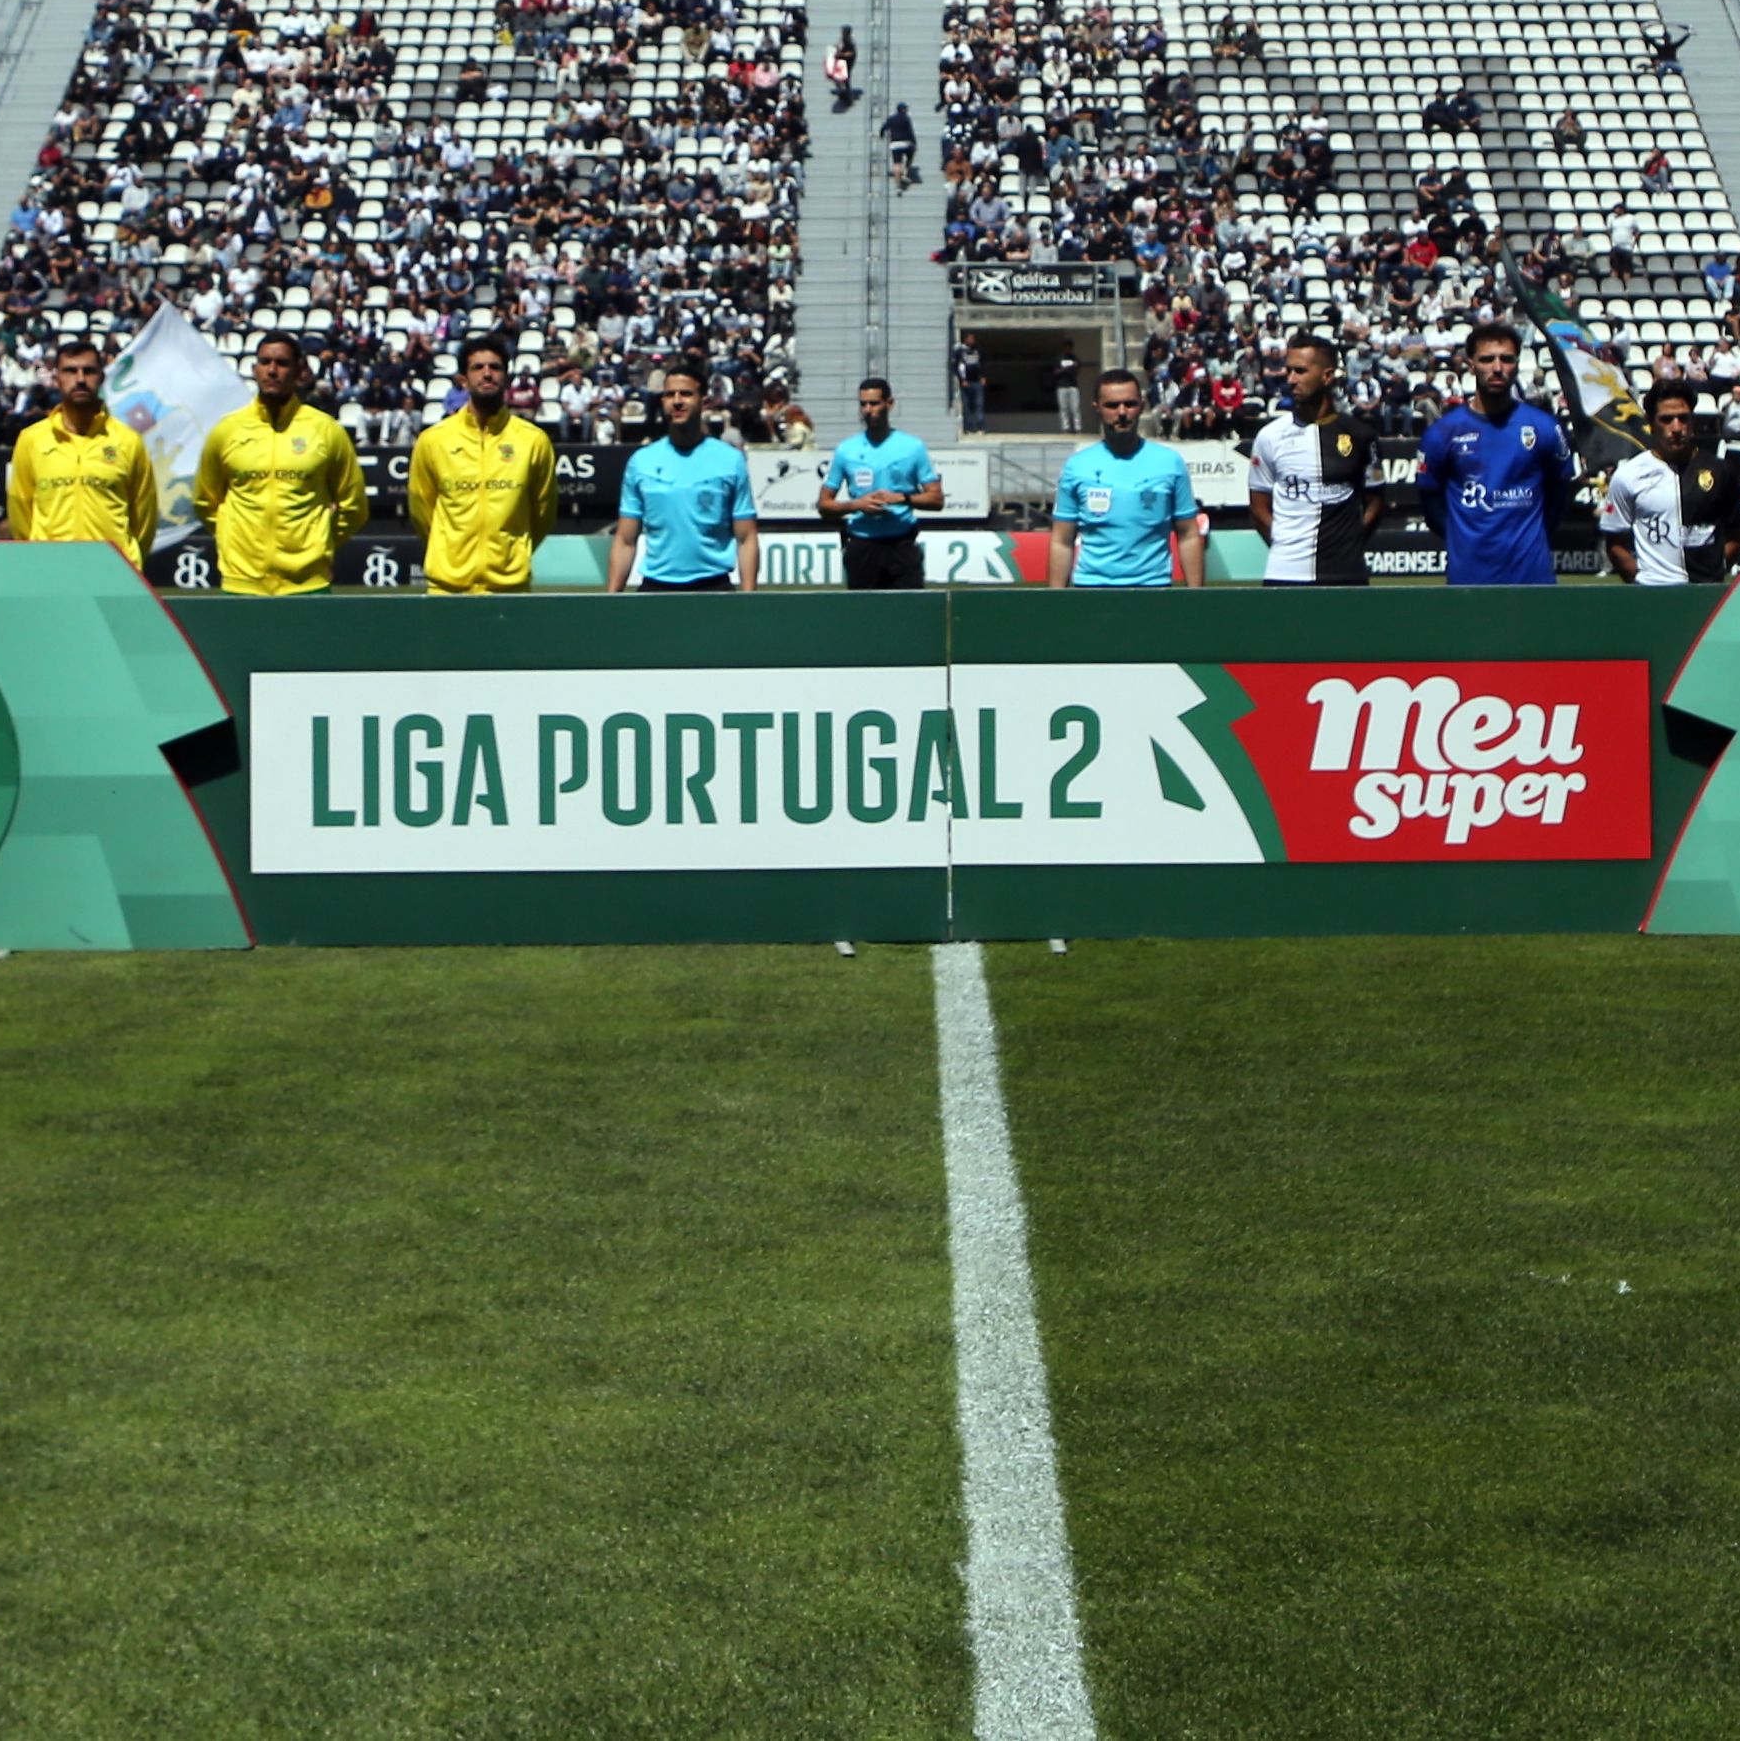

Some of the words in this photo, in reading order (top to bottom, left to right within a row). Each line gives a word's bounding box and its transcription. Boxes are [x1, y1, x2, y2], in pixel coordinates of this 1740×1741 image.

[1188, 460, 1235, 475] EIRAS
[943, 499, 980, 510] arvão
[311, 715, 510, 828] LIGA
[538, 707, 1023, 826] PORTUGAL
[1048, 705, 1102, 819] 2
[1348, 771, 1587, 845] super
